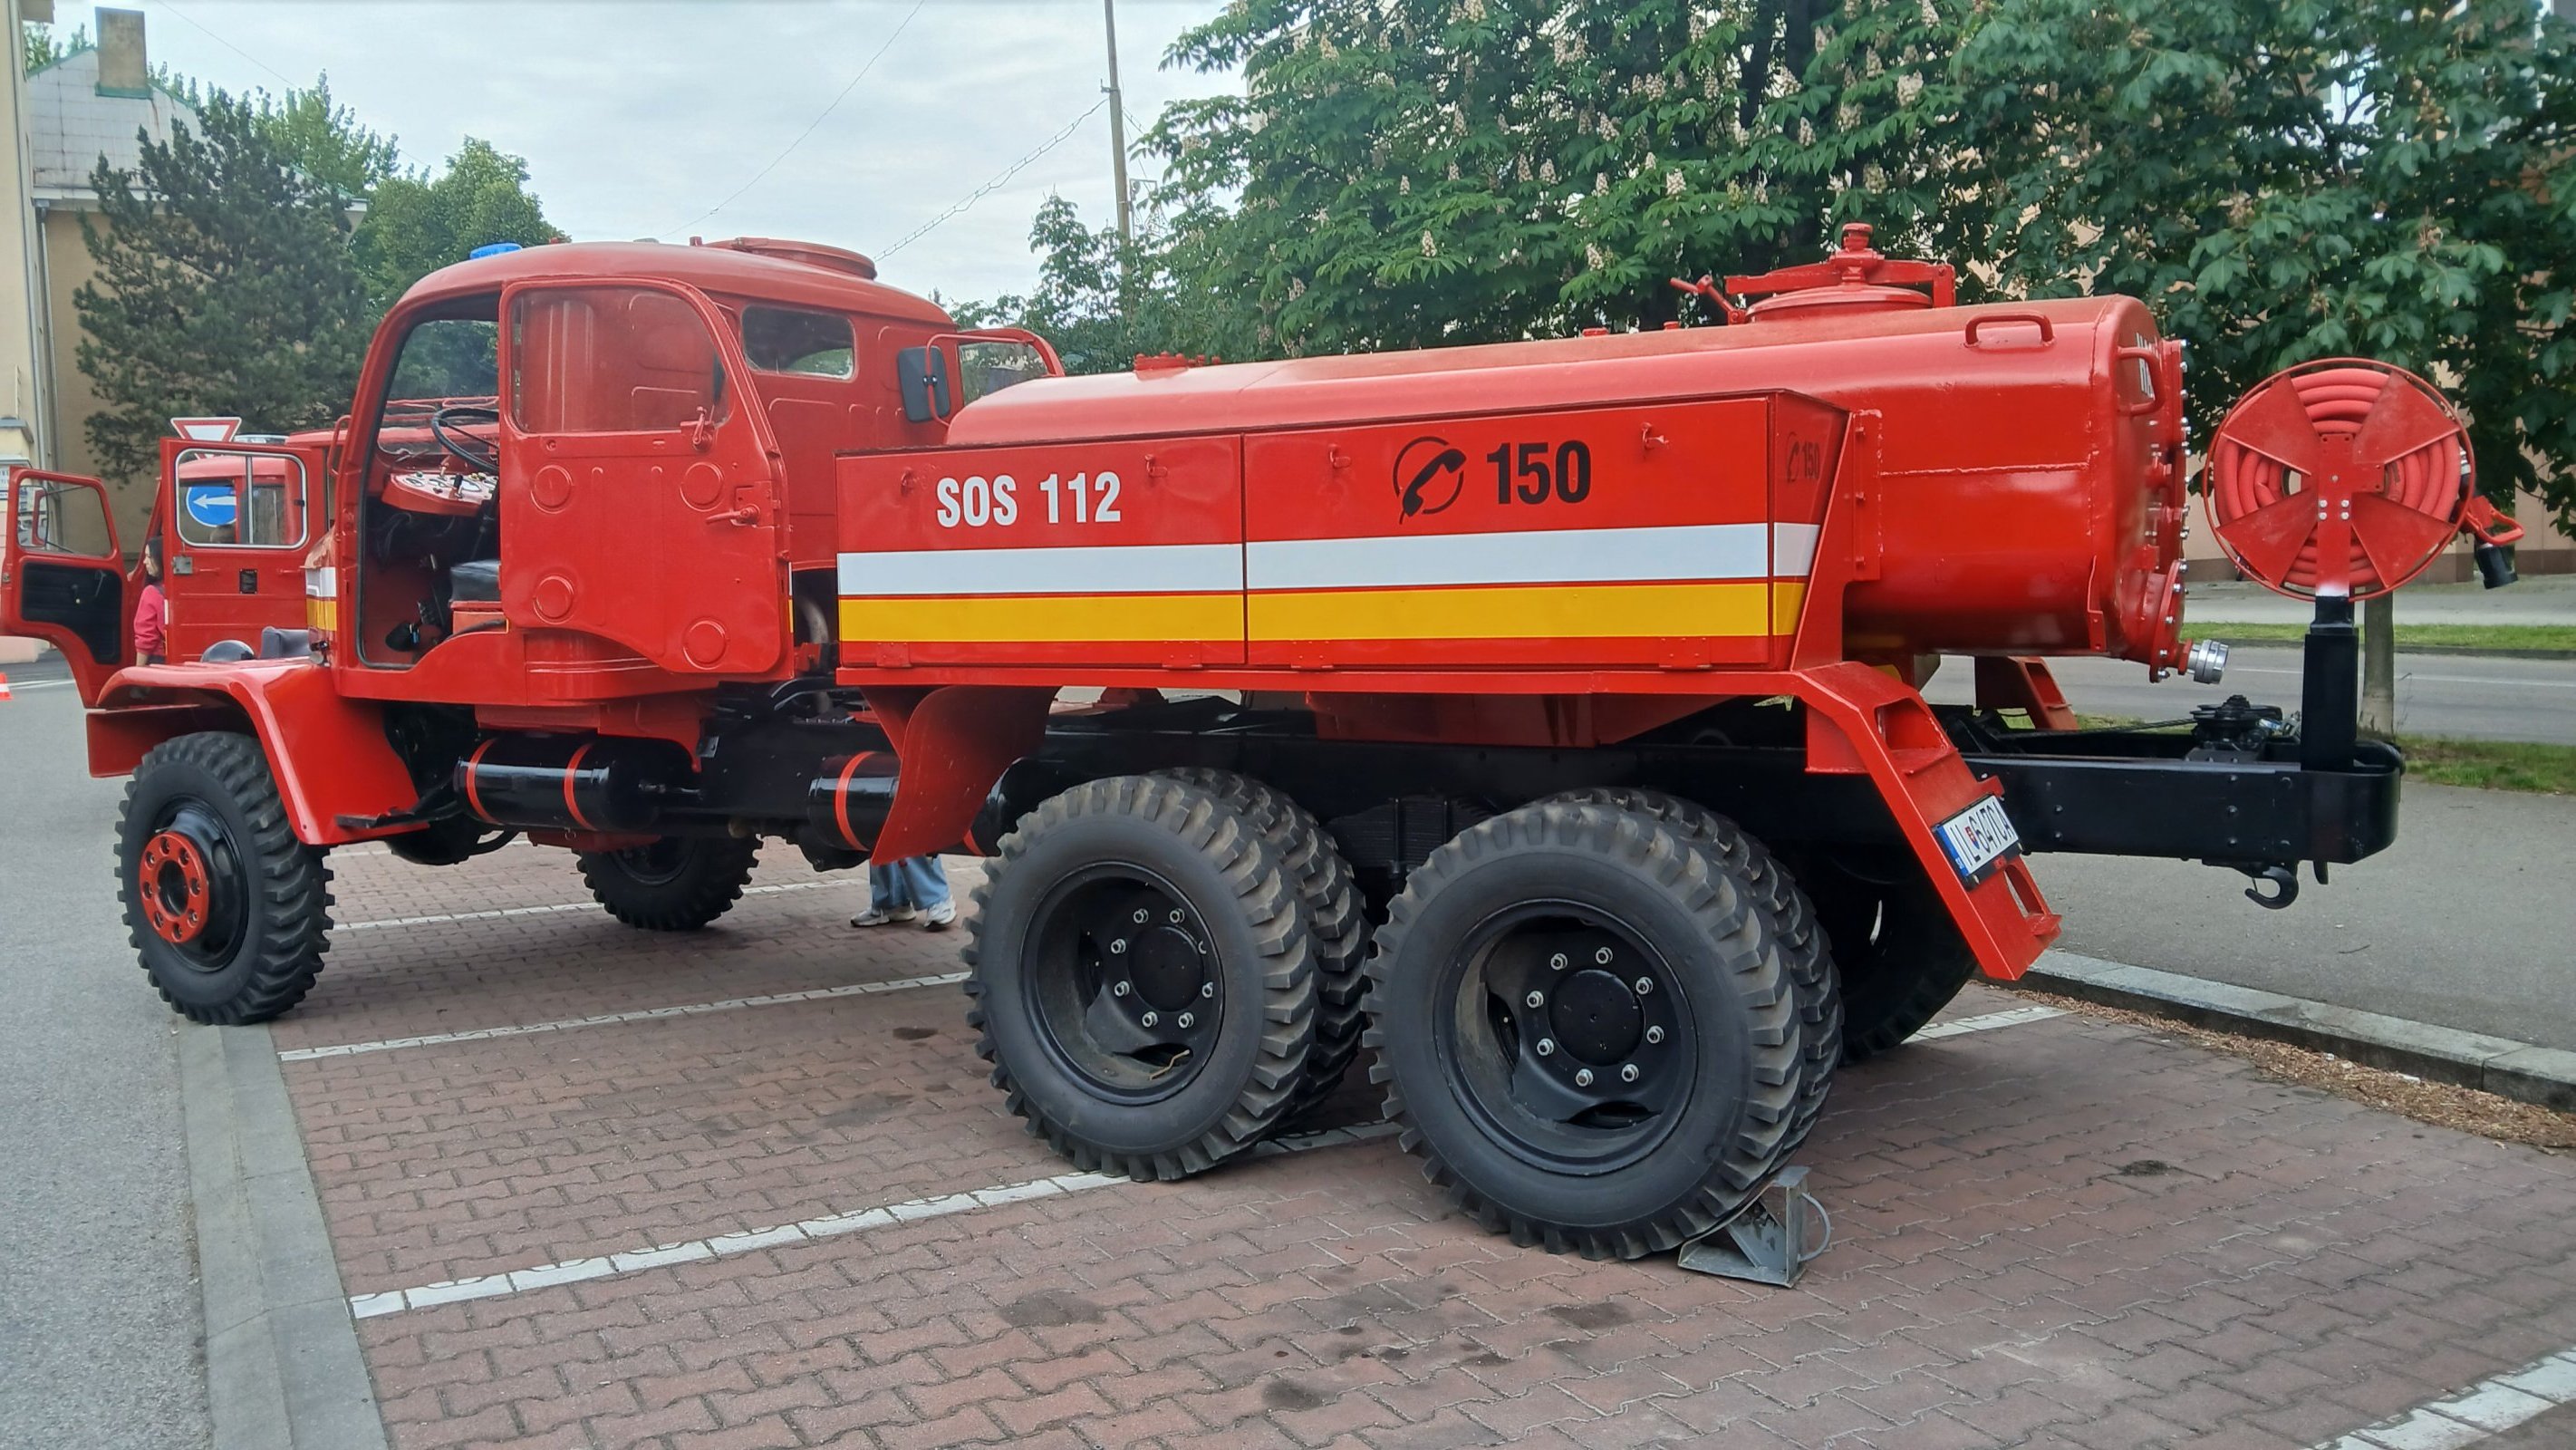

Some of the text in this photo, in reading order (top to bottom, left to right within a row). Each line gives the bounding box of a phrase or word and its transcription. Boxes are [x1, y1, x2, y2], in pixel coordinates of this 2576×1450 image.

[1486, 440, 1592, 505] 150
[1802, 441, 1821, 479] 150
[936, 470, 1122, 528] SOS 112
